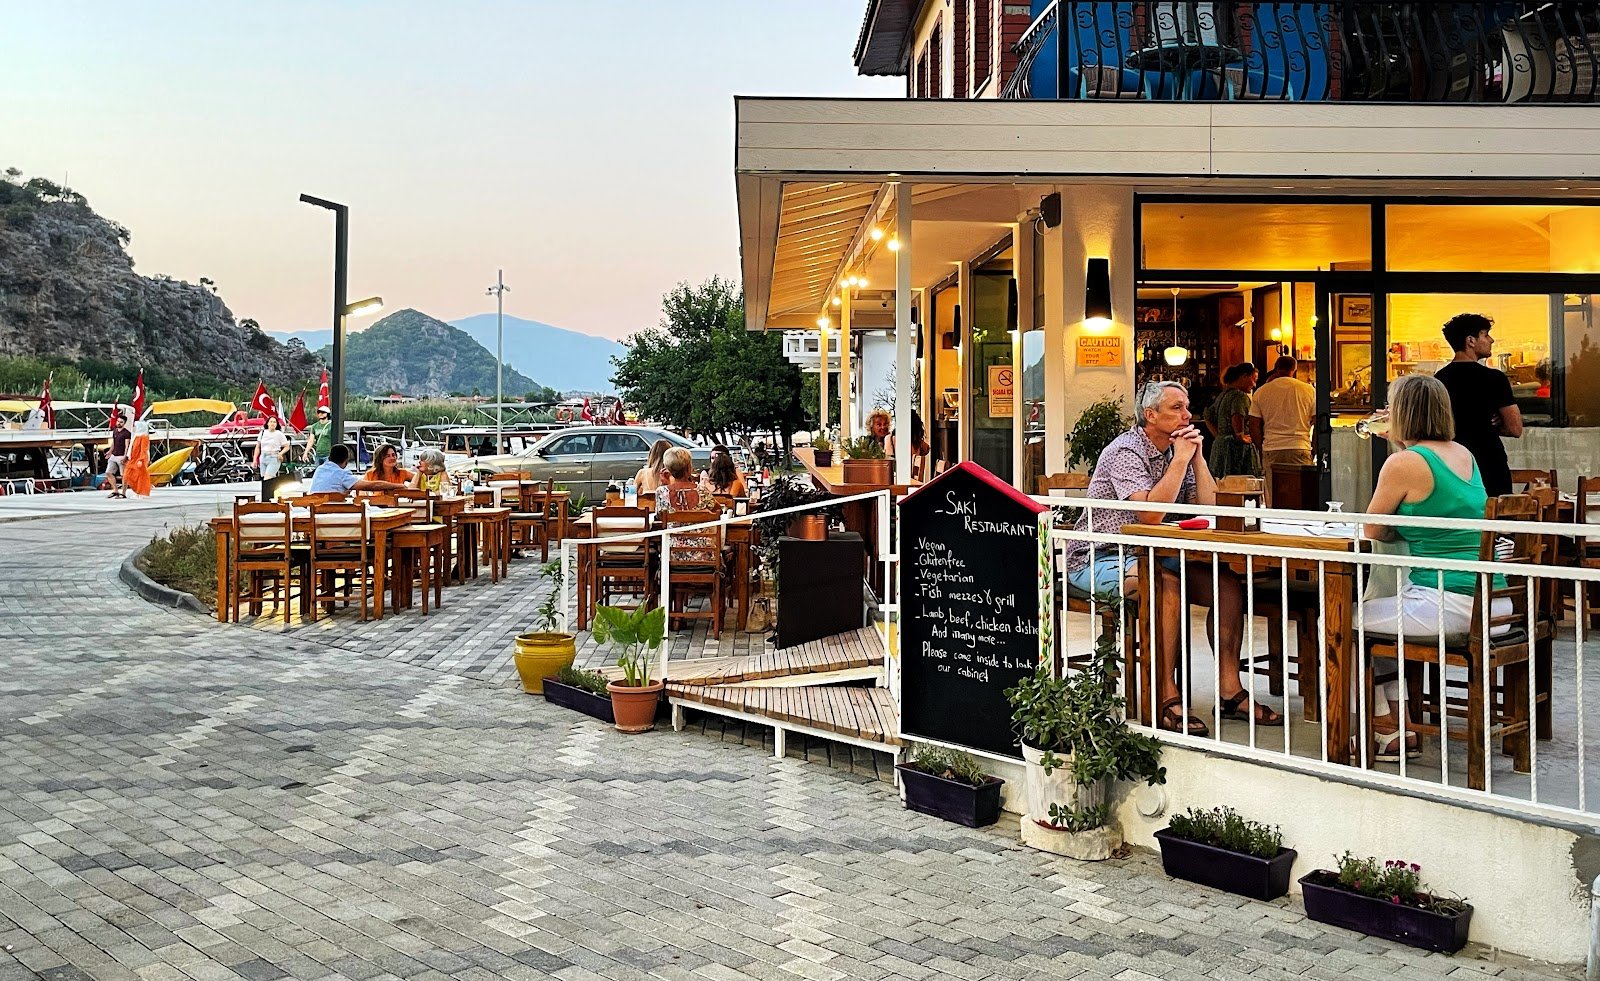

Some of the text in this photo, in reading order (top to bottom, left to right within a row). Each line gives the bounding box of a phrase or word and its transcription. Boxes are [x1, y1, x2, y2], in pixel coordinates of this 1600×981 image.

[1080, 338, 1119, 347] CAUTION
[964, 515, 1036, 537] RESTAURANT
[994, 593, 1015, 614] grill
[975, 614, 1012, 633] chicken
[931, 624, 948, 639] And
[951, 630, 976, 649] many
[922, 640, 948, 659] Please
[976, 651, 1000, 668] inside
[1002, 655, 1013, 669] to
[937, 664, 989, 683] our cabinet
